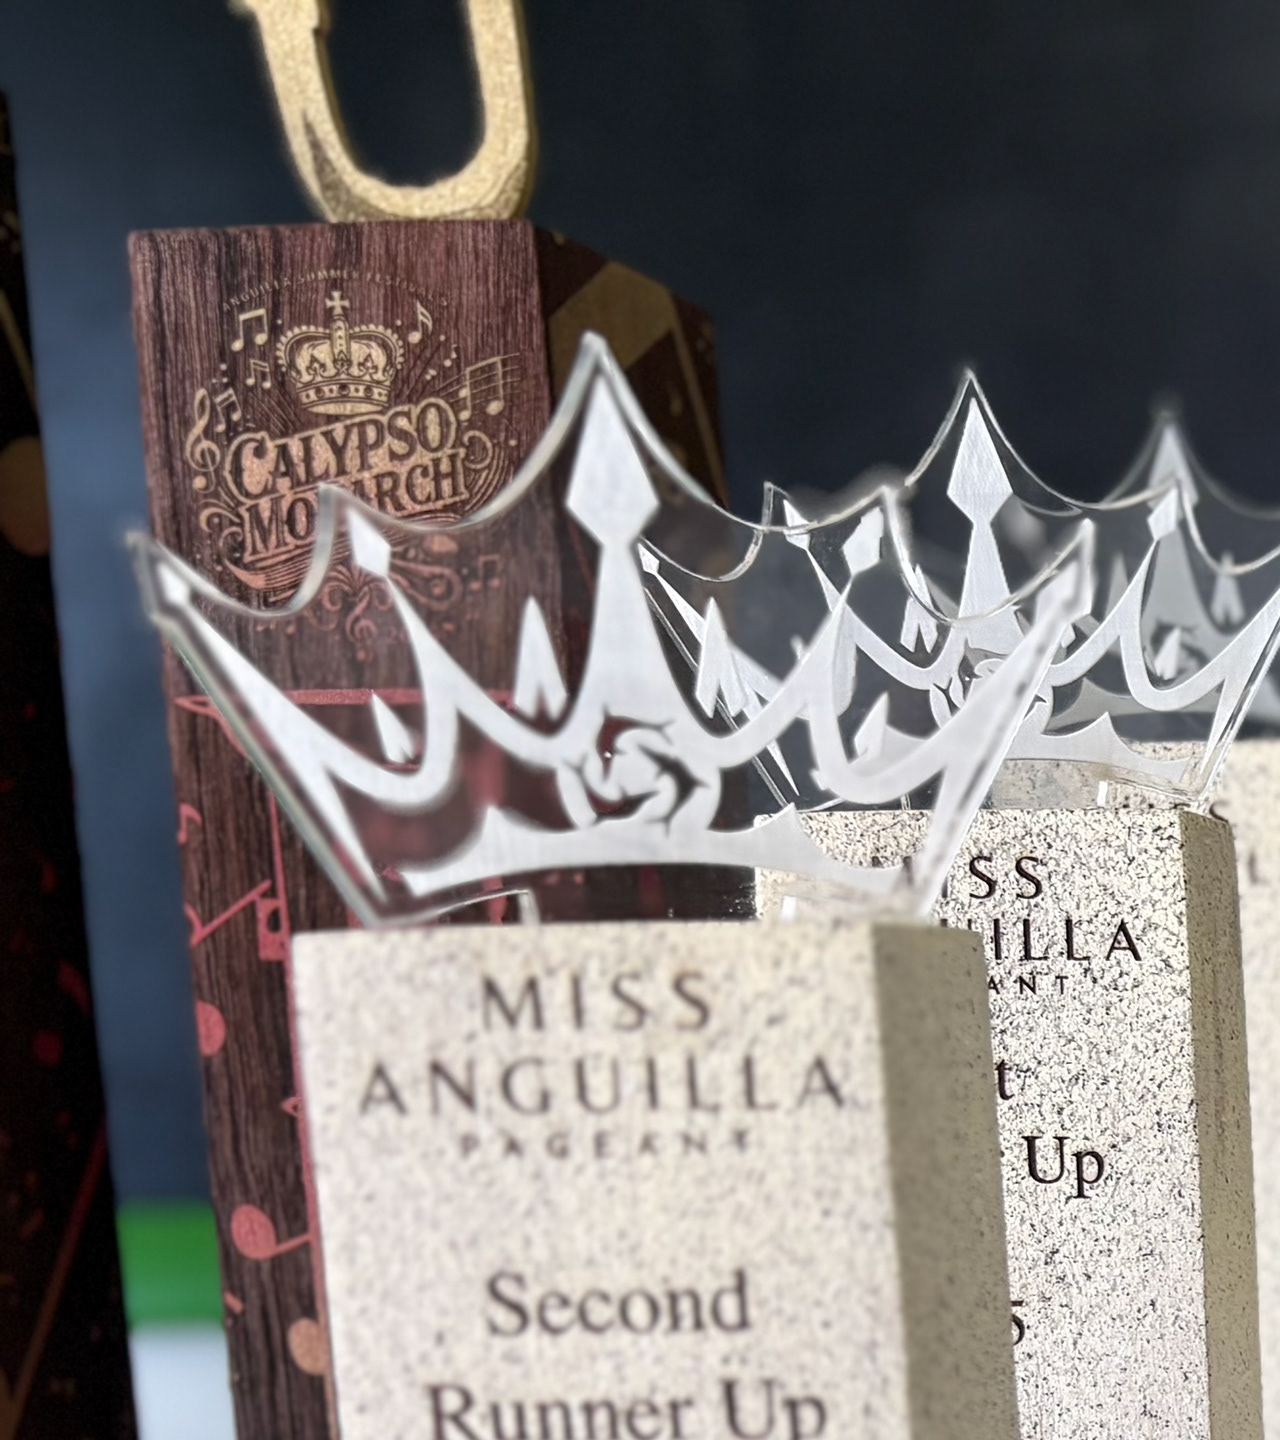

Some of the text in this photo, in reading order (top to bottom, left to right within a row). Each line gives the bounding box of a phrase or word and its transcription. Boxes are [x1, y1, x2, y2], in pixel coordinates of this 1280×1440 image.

[228, 401, 451, 500] CALYPSO
[246, 452, 466, 557] MOARCH
[482, 971, 712, 1033] MISS
[358, 1055, 848, 1116] ANGUILLA
[459, 1129, 754, 1160] PAGEANT
[1022, 1135, 1105, 1199] Up
[485, 1268, 752, 1337] Second
